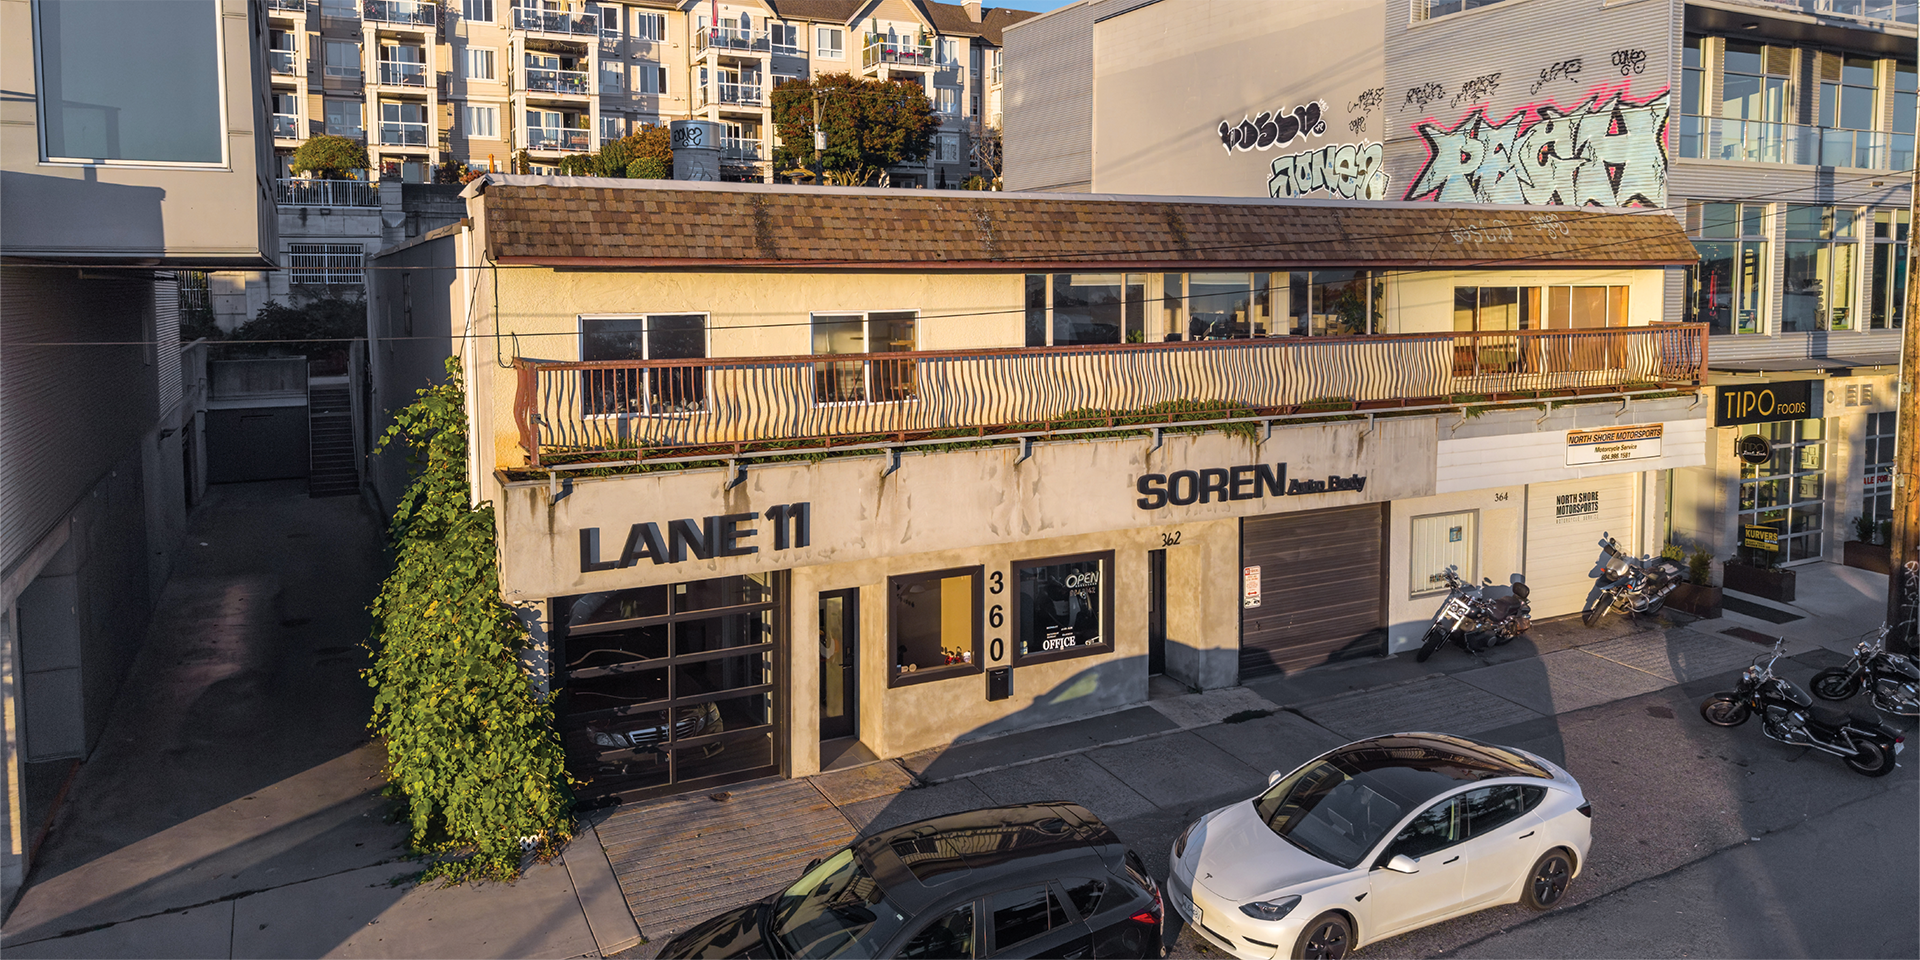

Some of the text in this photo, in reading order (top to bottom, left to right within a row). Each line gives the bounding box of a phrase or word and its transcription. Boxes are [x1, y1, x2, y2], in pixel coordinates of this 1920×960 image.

[1724, 389, 1806, 419] TIPO FOODS
[1568, 428, 1661, 444] NORTH SHORE MOTORSPORTS
[1594, 445, 1620, 453] Motorcycle
[1136, 462, 1367, 510] SOREN Auto Body
[1494, 492, 1509, 502] 364
[1556, 491, 1599, 505] NORTH SHORE
[1556, 501, 1599, 516] MOTORSPORTS
[579, 502, 811, 573] LANE 11
[1161, 530, 1182, 547] 362
[1745, 528, 1778, 541] KURVERS
[1066, 571, 1099, 588] OPEN
[1042, 635, 1076, 651] OFFICE
